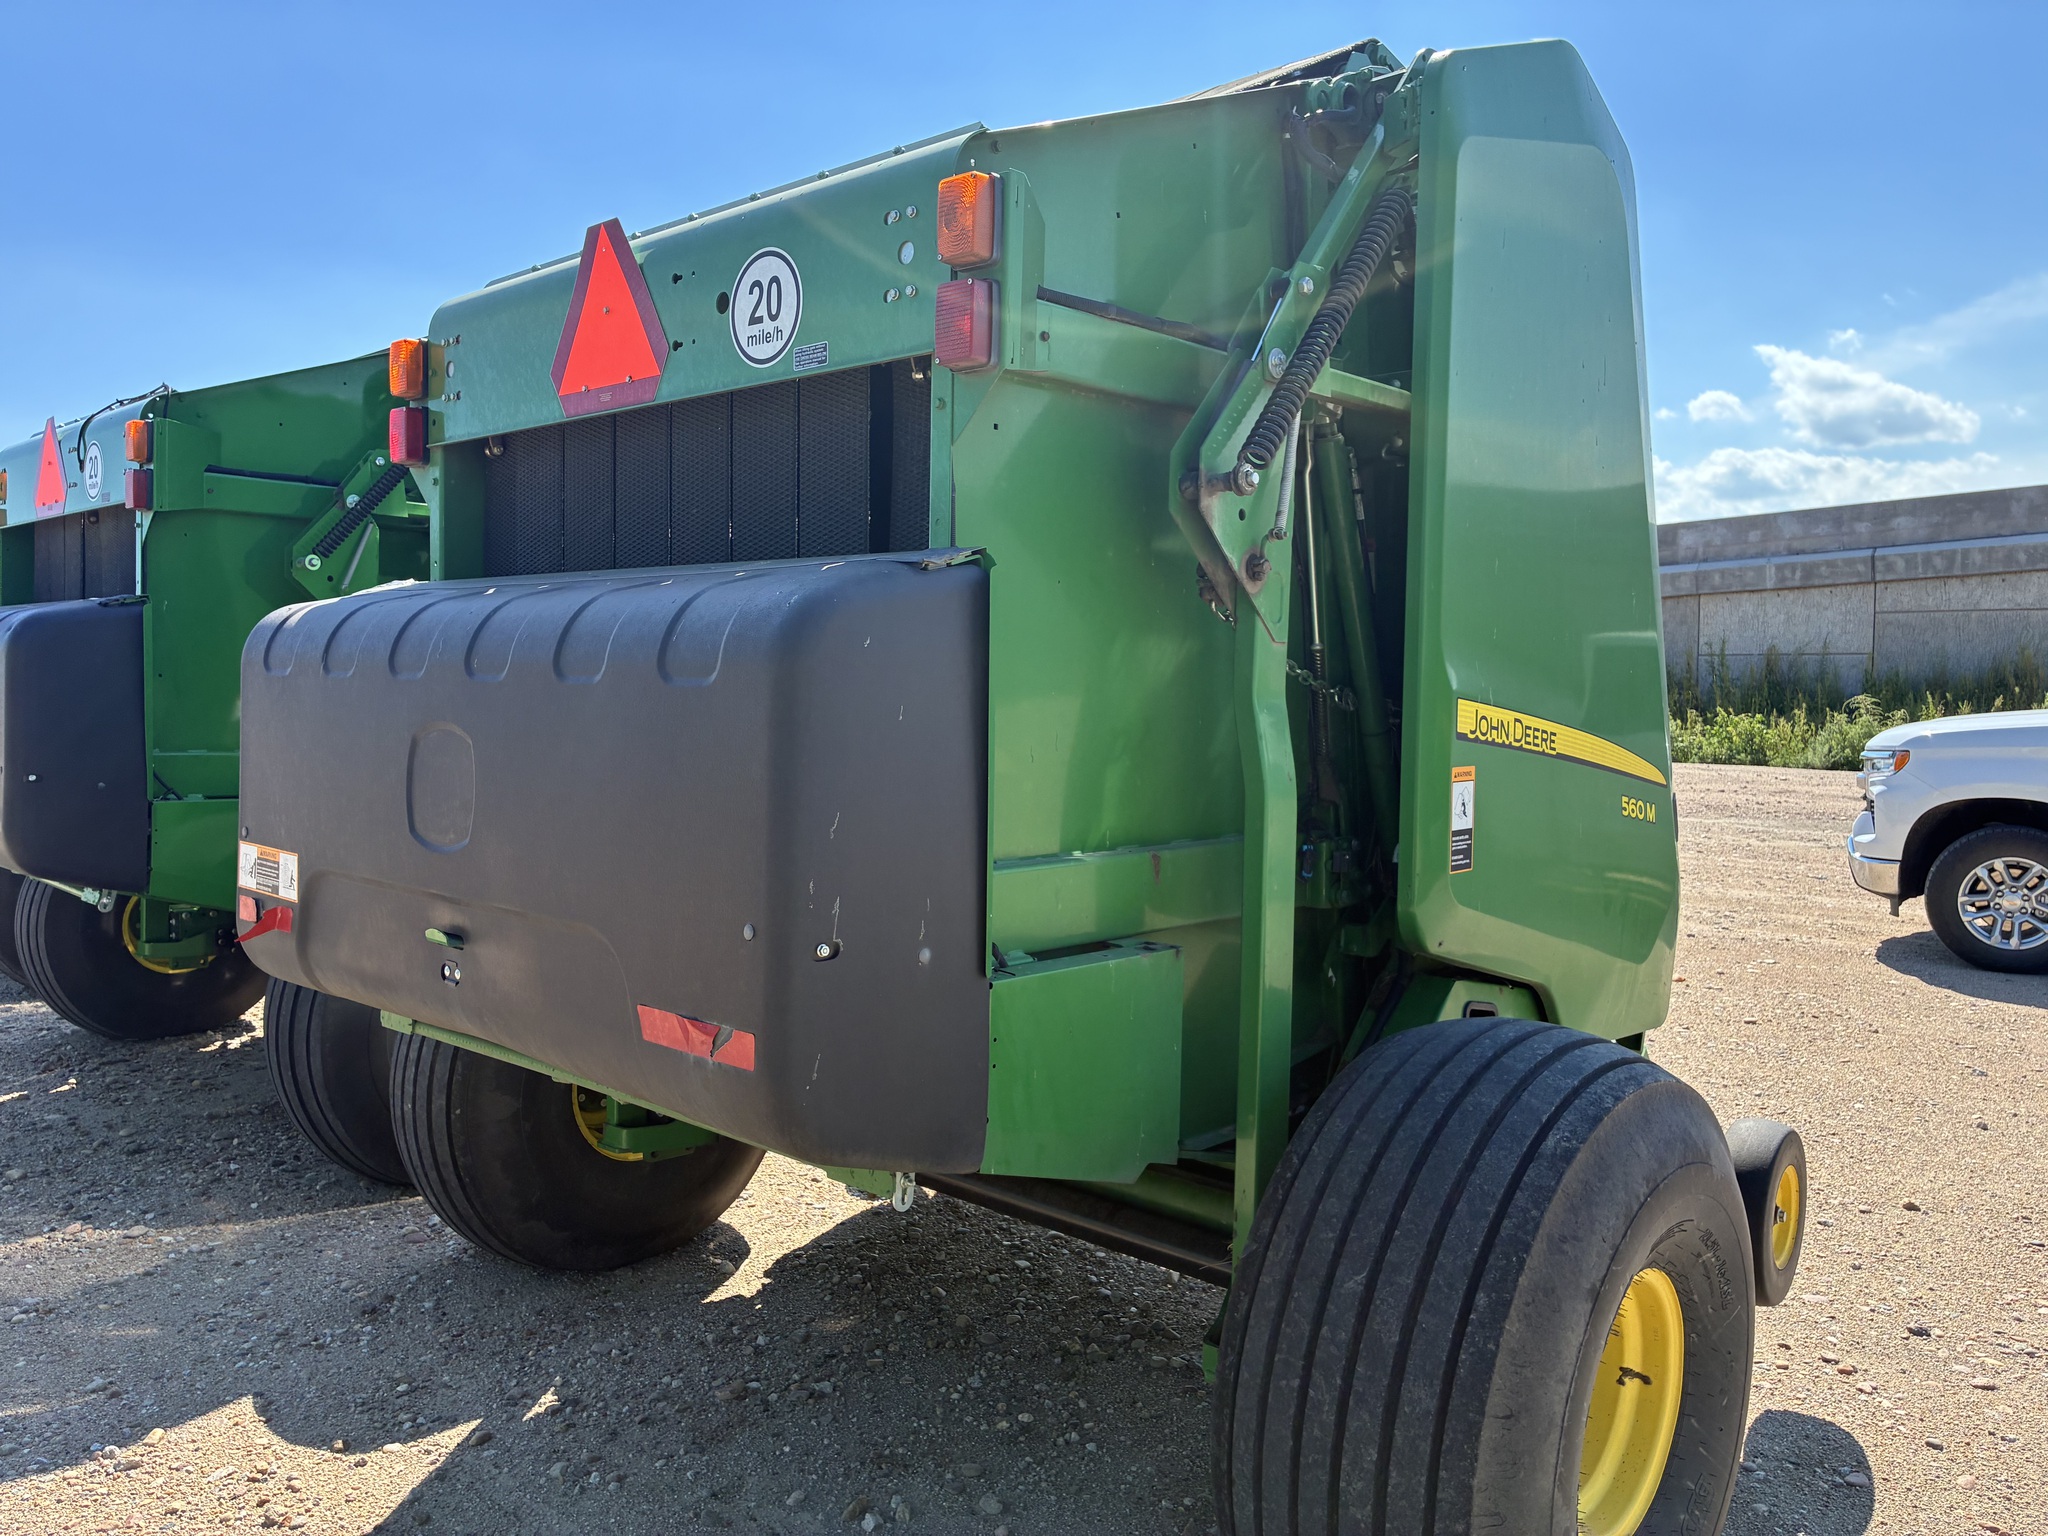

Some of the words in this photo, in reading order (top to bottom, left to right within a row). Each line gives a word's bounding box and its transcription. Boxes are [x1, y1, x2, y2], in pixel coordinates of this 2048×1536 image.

[748, 275, 783, 327] 20
[747, 326, 783, 348] mile/h
[88, 455, 99, 480] 20
[1469, 709, 1510, 740] JOHN
[1513, 717, 1557, 752] DEERE
[1621, 796, 1645, 821] 560
[1646, 803, 1656, 824] M
